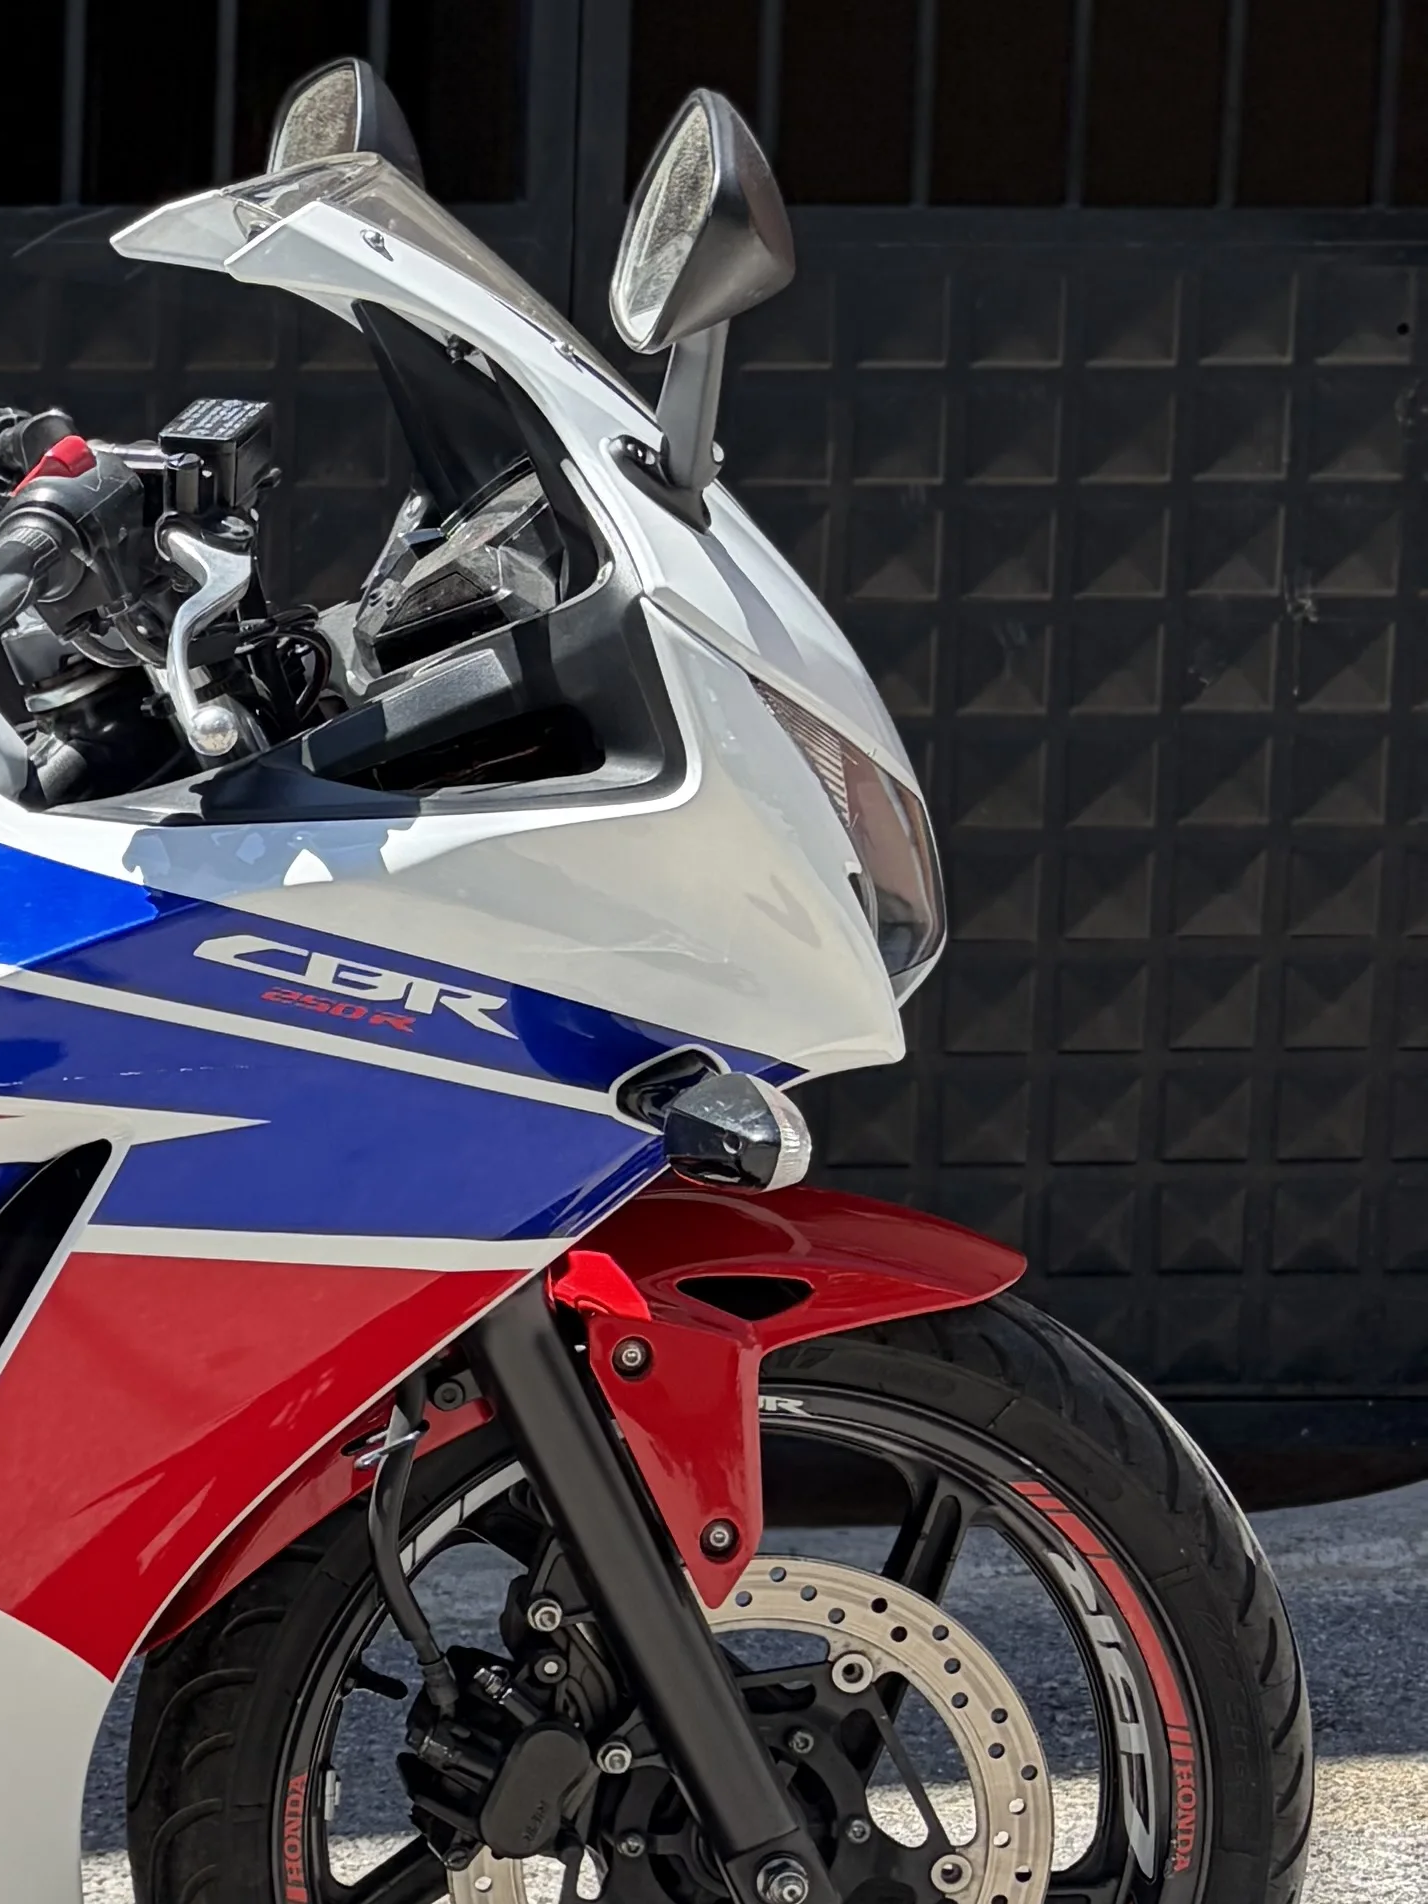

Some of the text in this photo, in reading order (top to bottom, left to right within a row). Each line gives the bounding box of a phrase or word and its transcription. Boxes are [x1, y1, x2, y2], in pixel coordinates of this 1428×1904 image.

[193, 934, 520, 1040] CBR
[1048, 1552, 1155, 1879] CBR
[284, 1773, 309, 1882] HONDA
[1173, 1764, 1198, 1872] HONDA
